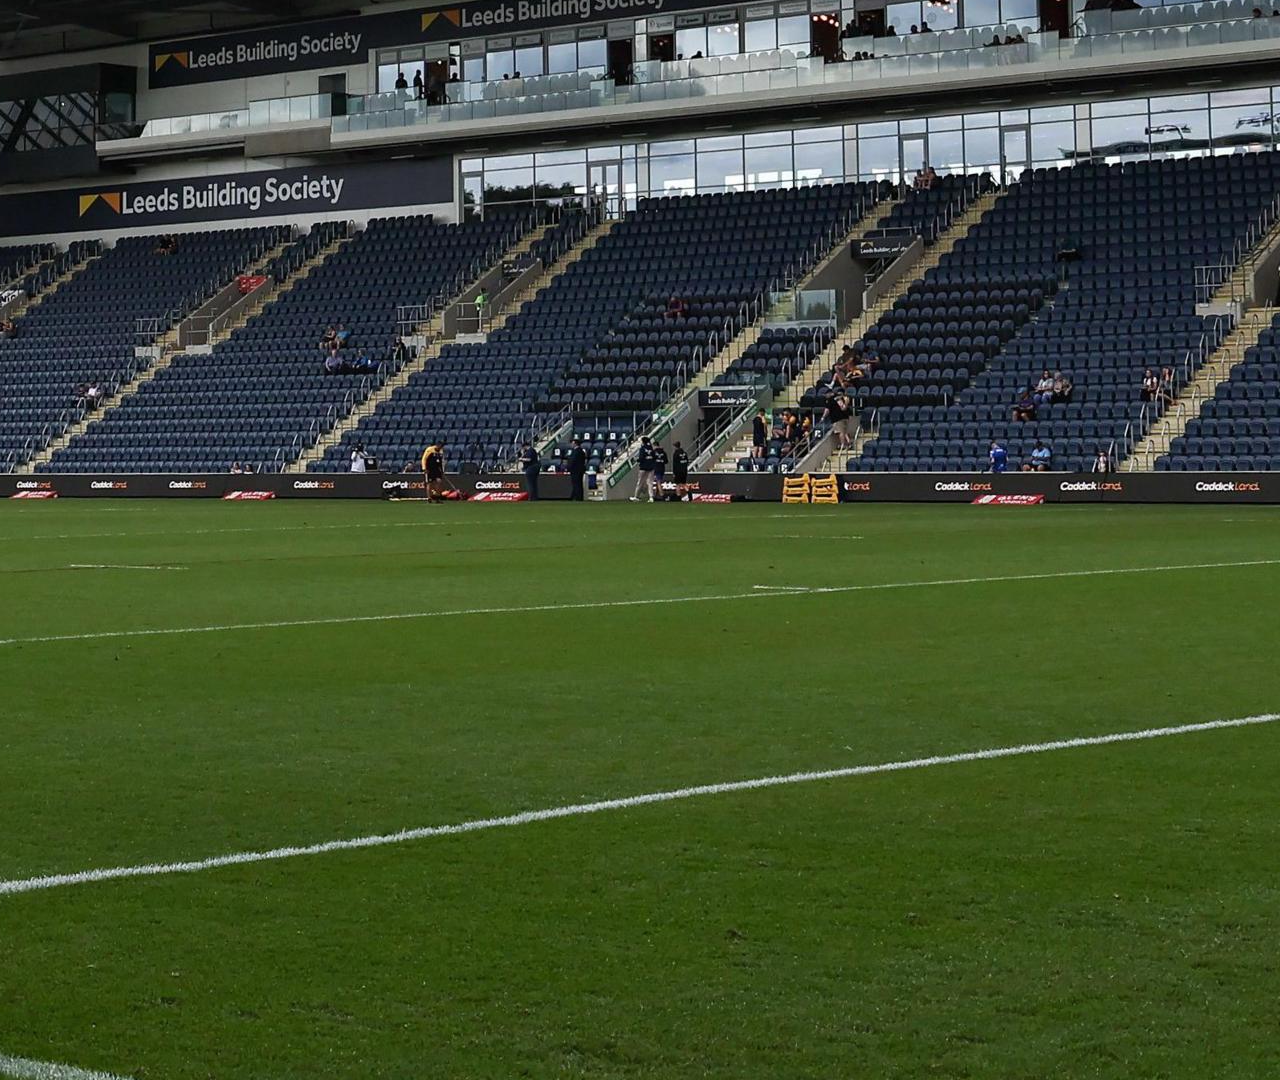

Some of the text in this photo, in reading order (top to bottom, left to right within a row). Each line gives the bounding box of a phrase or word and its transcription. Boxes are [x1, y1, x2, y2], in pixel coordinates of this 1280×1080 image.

[461, 4, 515, 28] Leeds
[189, 31, 361, 69] Leeds Building Society
[122, 174, 343, 215] Leeds Building Society
